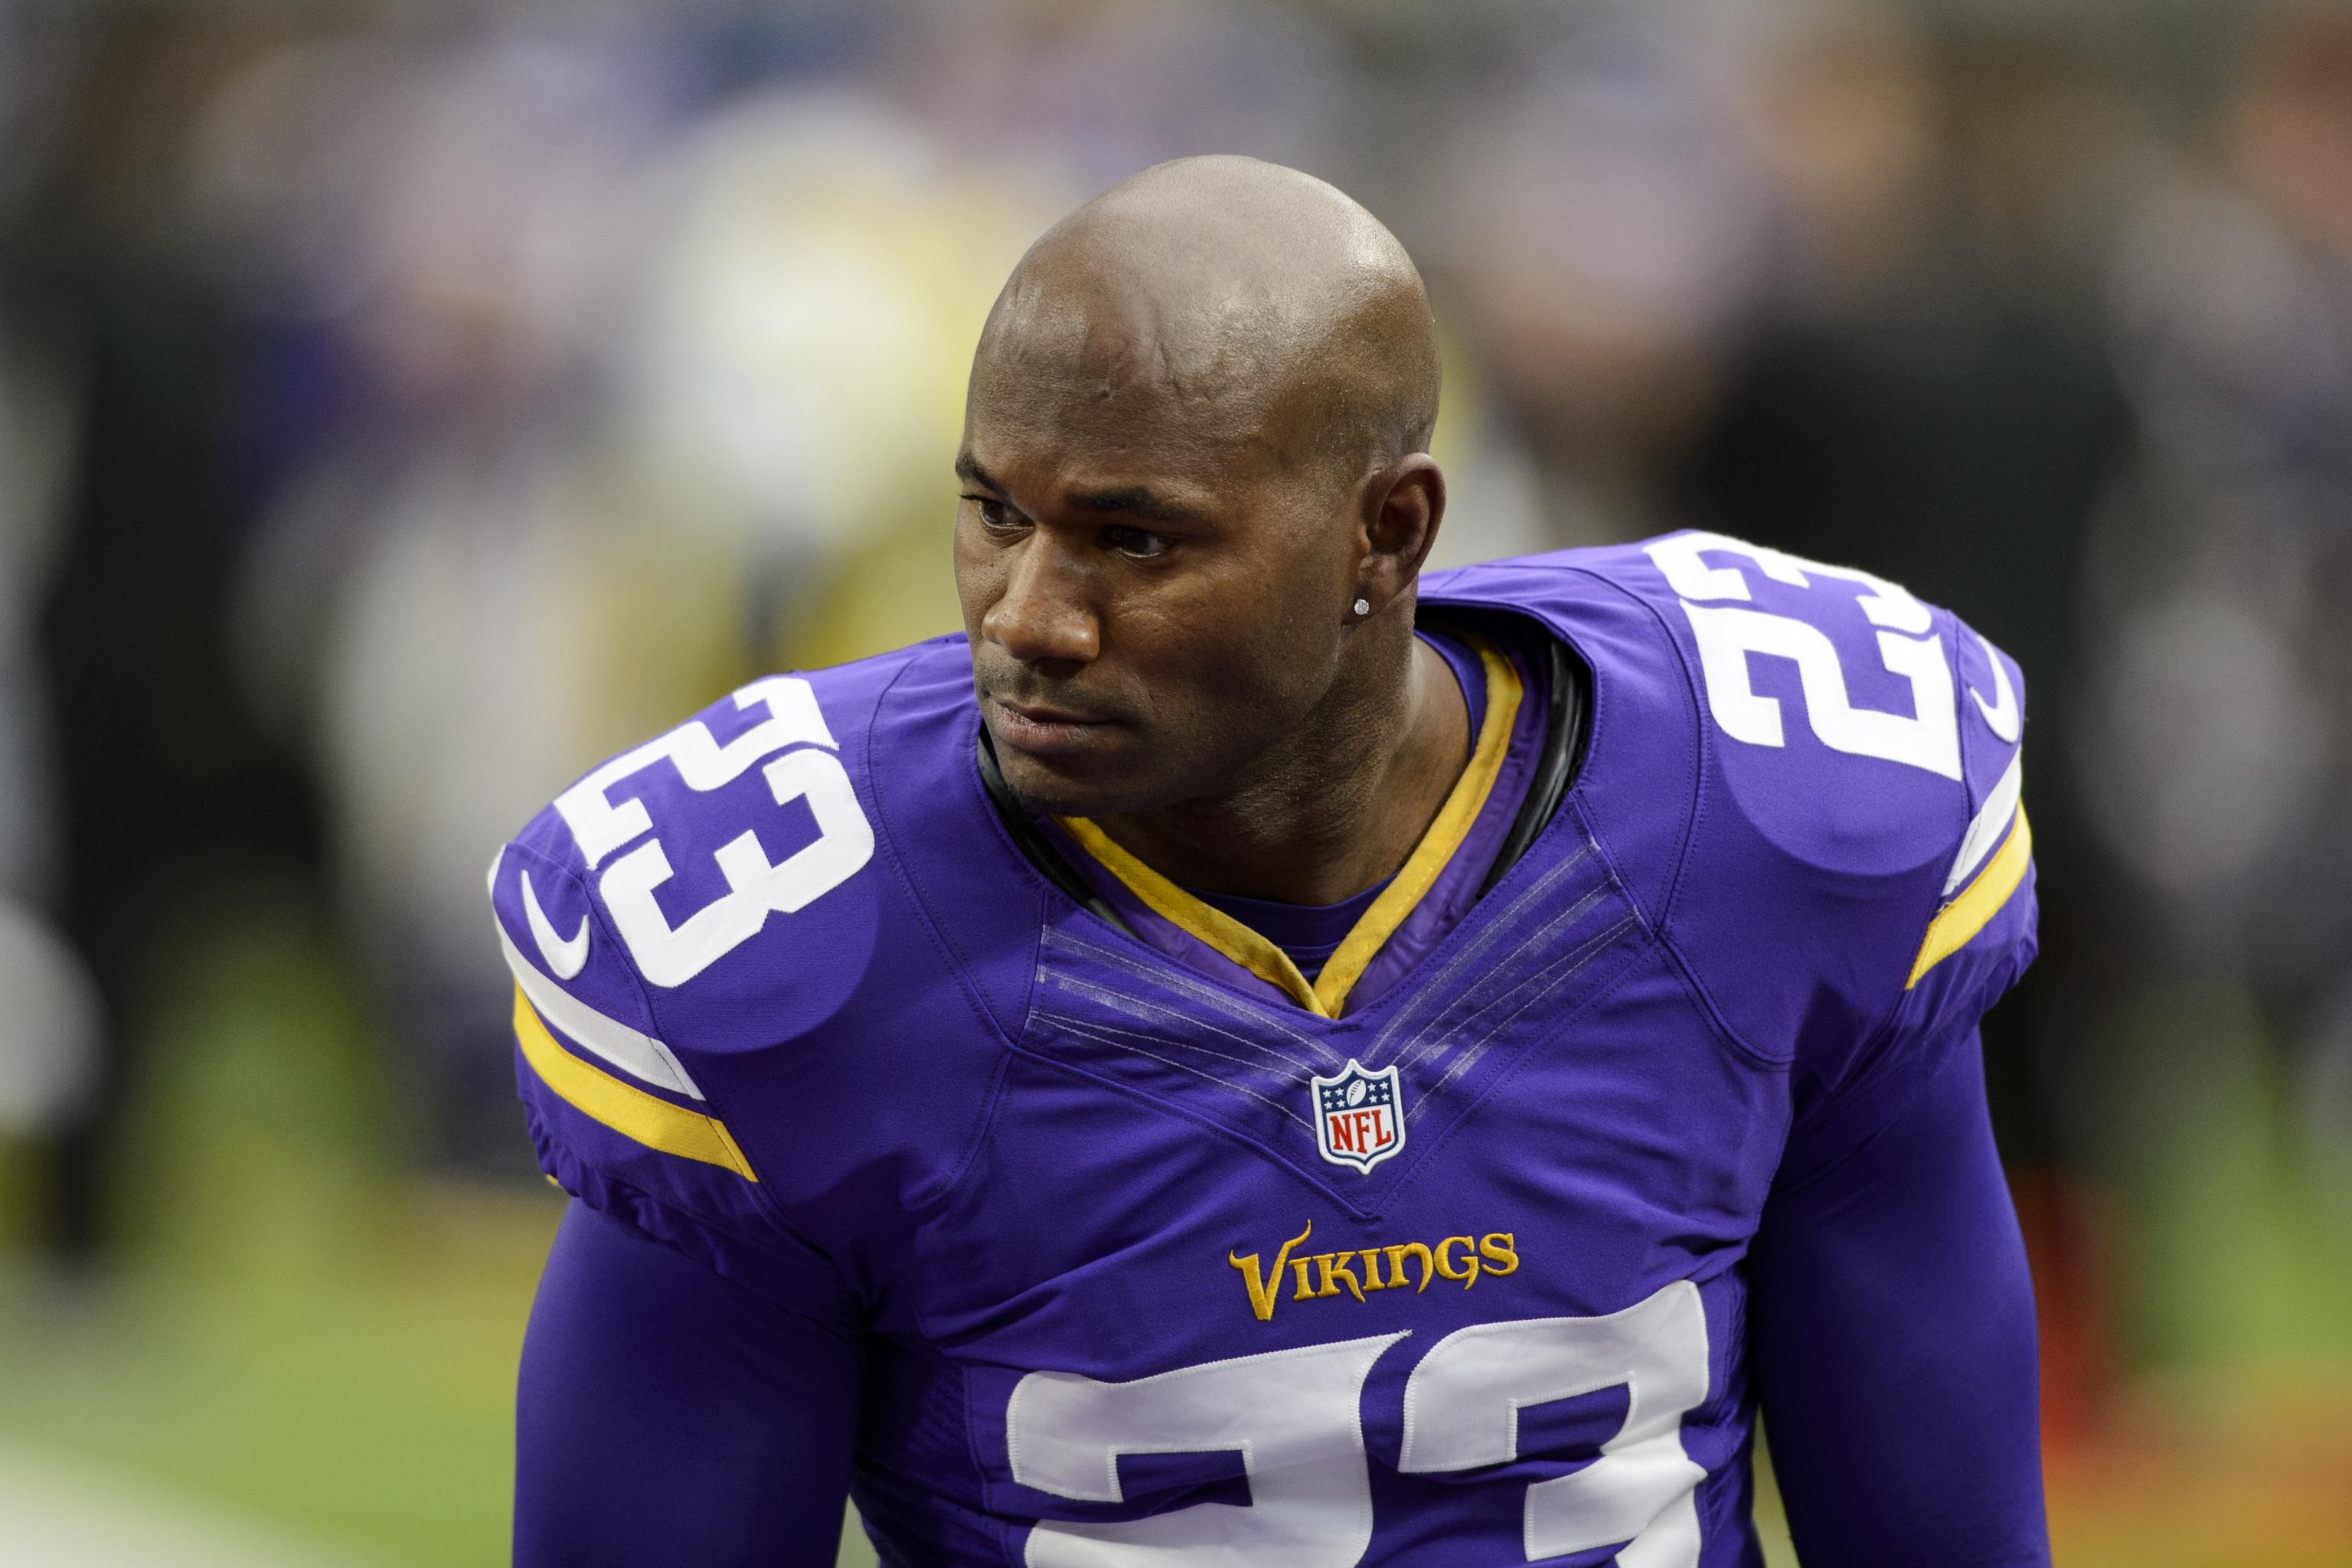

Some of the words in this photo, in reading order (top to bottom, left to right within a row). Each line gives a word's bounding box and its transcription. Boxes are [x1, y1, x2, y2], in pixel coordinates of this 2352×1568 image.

[1642, 531, 1962, 782] 23
[553, 676, 874, 988] 23
[1329, 1109, 1392, 1153] NFL
[1006, 1279, 1709, 1568] 23
